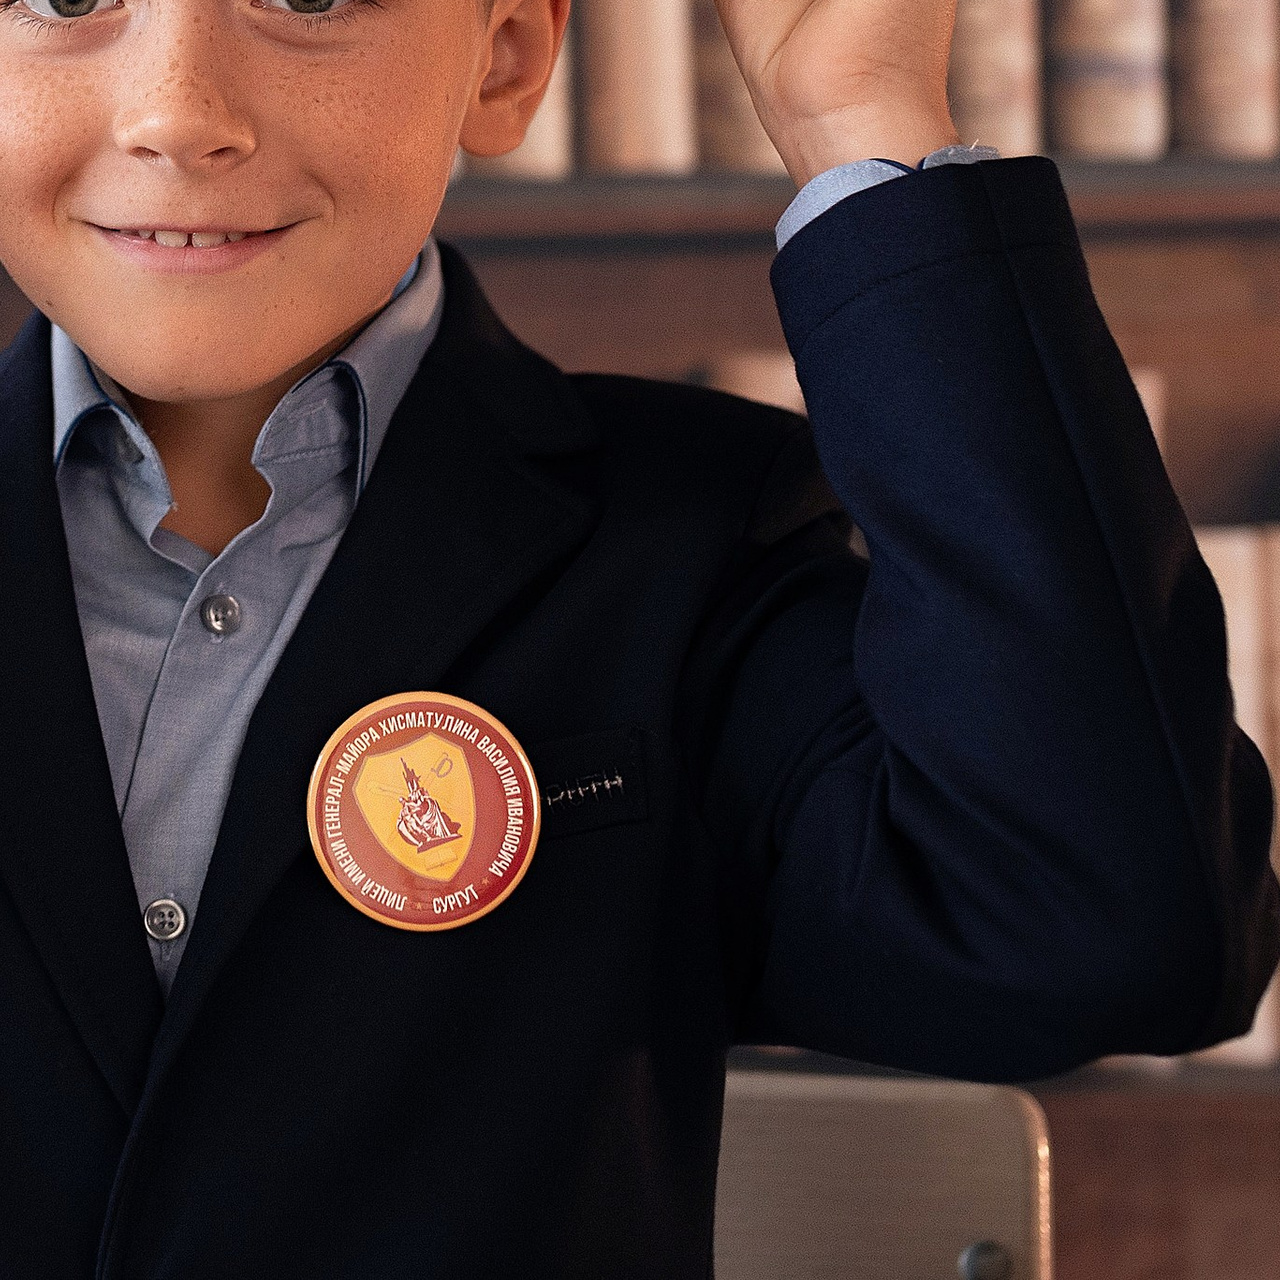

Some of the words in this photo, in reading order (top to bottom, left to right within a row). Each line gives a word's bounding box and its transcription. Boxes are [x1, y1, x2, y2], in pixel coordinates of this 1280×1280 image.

[378, 711, 480, 744] ХИСМАТУЛИНА
[325, 726, 380, 837] ГЕНЕРАЛ-МАЙОРА
[476, 735, 521, 796] ВАСИЛИЯ
[488, 797, 524, 878] ИВАНОВИЧА
[330, 840, 366, 882] ИМЕНИ
[361, 881, 407, 912] ЛИЦЕЙ
[432, 884, 479, 914] СУРГУТ
